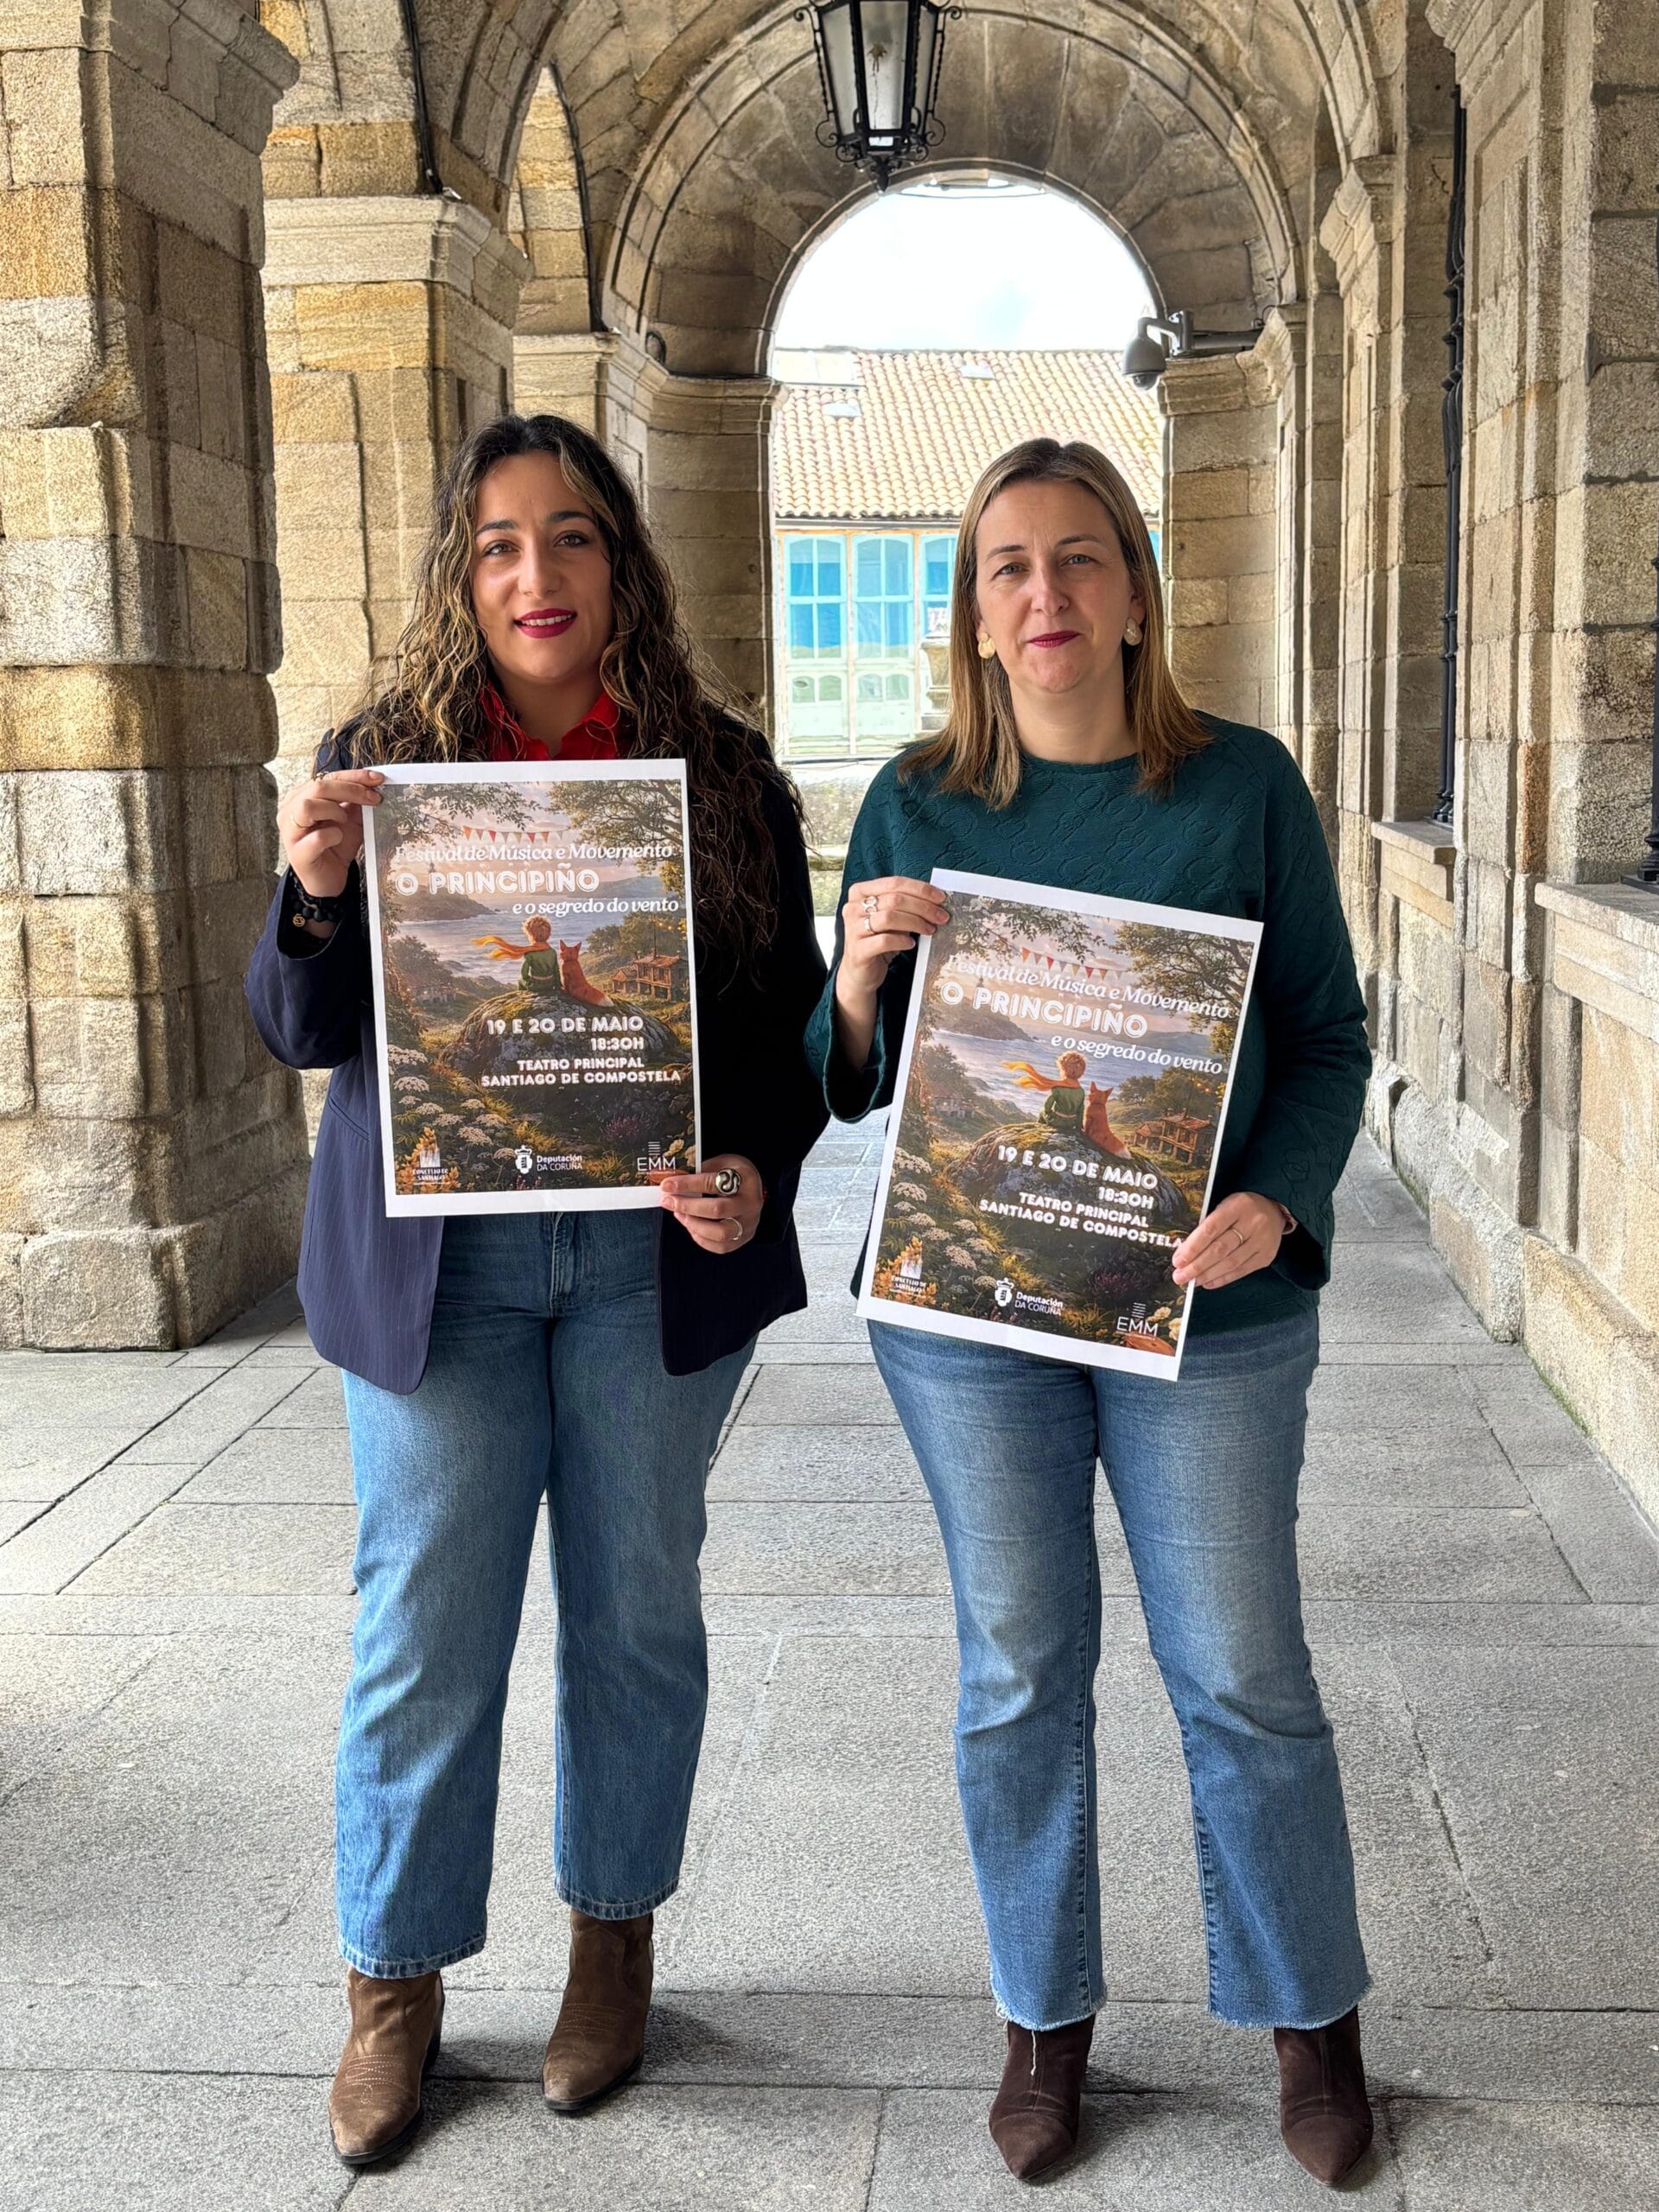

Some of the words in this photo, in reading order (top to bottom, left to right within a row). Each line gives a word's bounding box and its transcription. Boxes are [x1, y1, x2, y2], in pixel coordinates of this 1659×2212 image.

[395, 844, 462, 861] Festival
[464, 844, 487, 861] de
[488, 843, 553, 861] Música
[556, 848, 565, 860] e
[569, 842, 672, 860] Movemento
[395, 872, 419, 896] O
[429, 862, 600, 895] PRINCIPIÑO
[512, 903, 523, 914] e
[524, 903, 536, 914] o
[537, 898, 604, 918] segredo
[607, 897, 629, 913] do
[632, 899, 679, 912] vento
[948, 955, 1015, 982] Festival
[1015, 968, 1039, 986] de
[1040, 972, 1107, 998] Música
[1109, 988, 1120, 1000] e
[1122, 986, 1230, 1019] Movemento
[940, 981, 964, 1005] O
[973, 987, 1148, 1039] PRINCIPIÑO
[486, 1019, 506, 1035] 19
[512, 1018, 524, 1034] E
[529, 1018, 556, 1034] 20
[562, 1016, 587, 1033] DE
[591, 1015, 644, 1033] MAIO
[590, 1036, 645, 1052] 18:30H
[517, 1059, 570, 1071] TEATRO
[574, 1057, 645, 1070] PRINCIPAL
[1051, 1035, 1062, 1046] e
[1064, 1037, 1076, 1049] o
[1077, 1039, 1147, 1062] segredo
[1147, 1048, 1171, 1065] do
[1173, 1055, 1223, 1075] vento
[481, 1072, 556, 1087] SANTIAGO
[562, 1072, 580, 1084] DE
[584, 1071, 681, 1084] COMPOSTELA
[537, 1154, 583, 1165] Deputación
[537, 1163, 549, 1172] DA
[550, 1160, 583, 1172] CORUÑA
[637, 1156, 677, 1172] EMM
[997, 1145, 1017, 1163] 19
[1021, 1150, 1035, 1166] E
[1039, 1153, 1067, 1173] 20
[1071, 1160, 1100, 1179] DE
[1102, 1166, 1159, 1190] MAIO
[1097, 1186, 1154, 1210] 18:30H
[1019, 1192, 1072, 1213] TEATRO
[1075, 1203, 1149, 1228] PRINCIPAL
[979, 1199, 1056, 1224] SANTIAGO
[1059, 1215, 1079, 1230] DE
[1083, 1219, 1183, 1249] COMPOSTELA
[1014, 1300, 1026, 1310] DA
[1027, 1302, 1063, 1317] CORUÑA
[1015, 1291, 1064, 1308] Deputación
[1116, 1316, 1159, 1338] EMM
